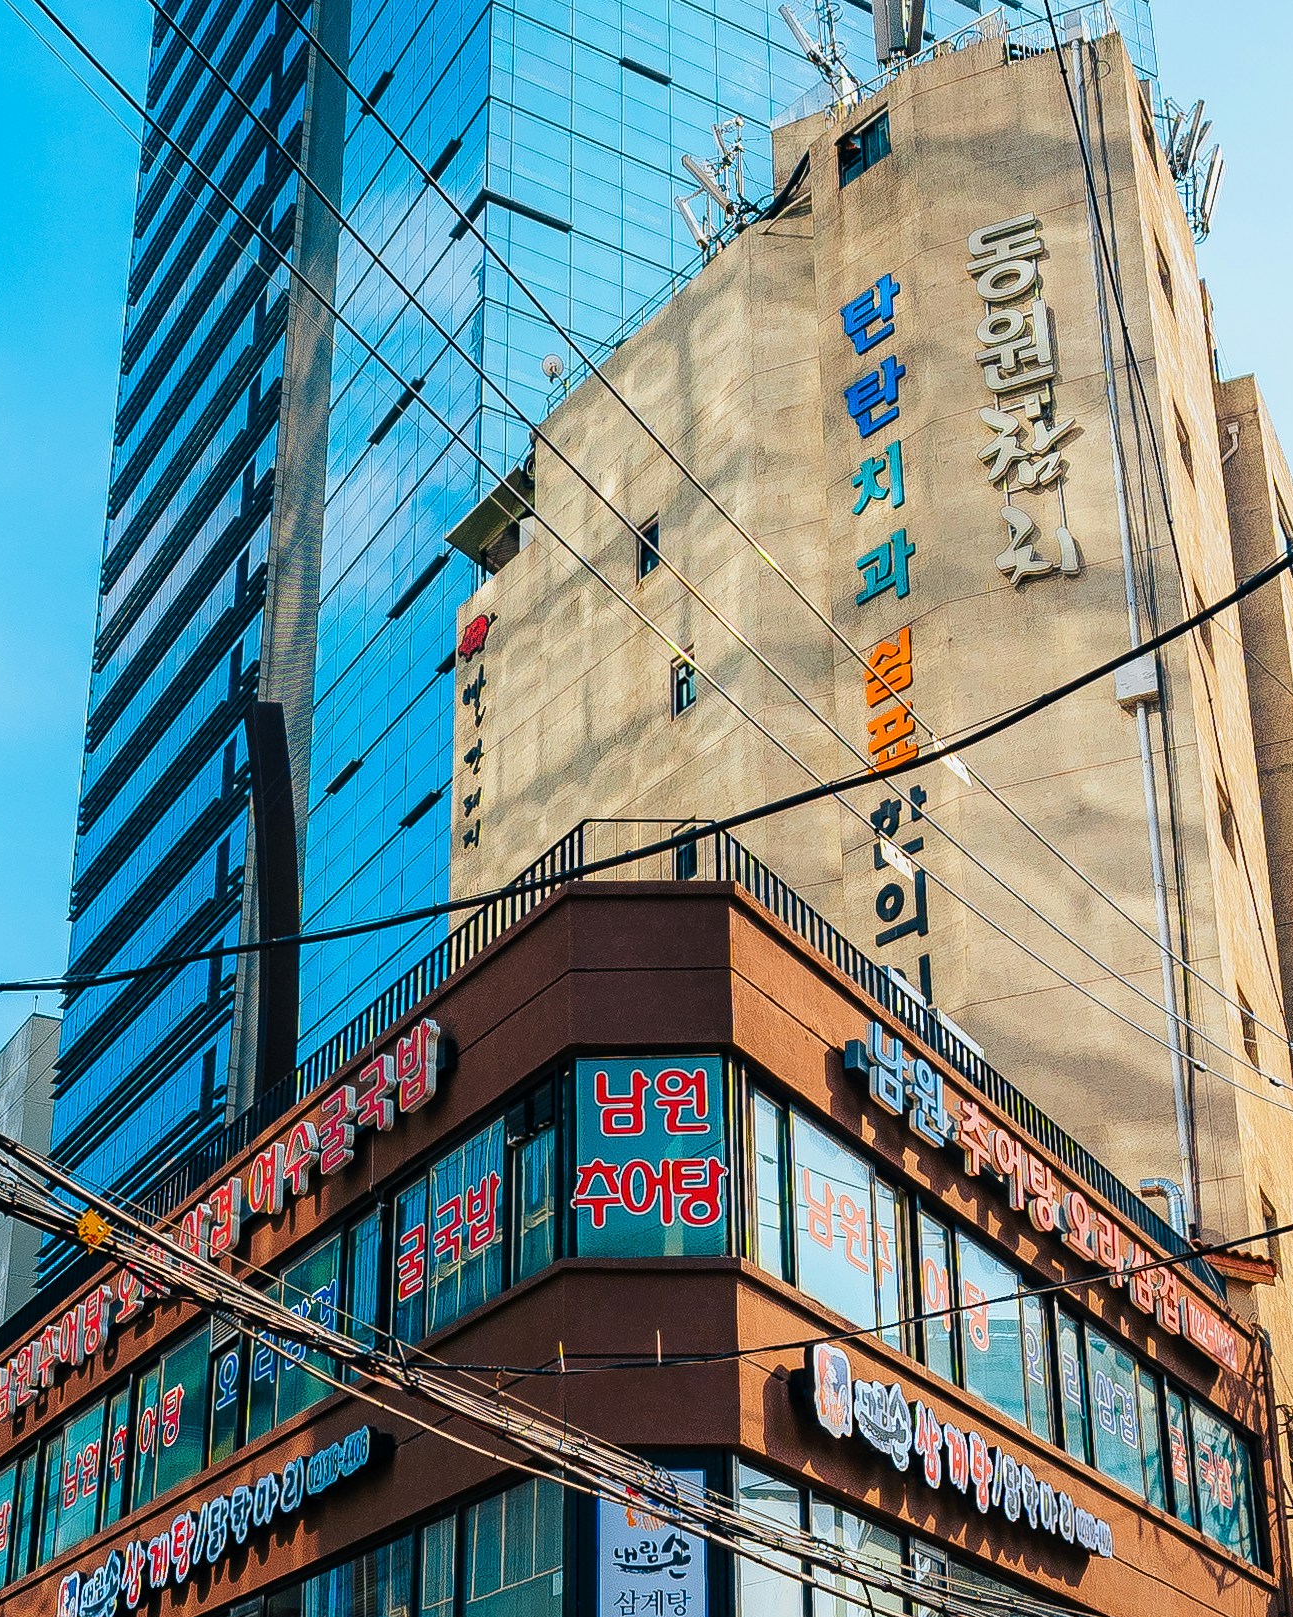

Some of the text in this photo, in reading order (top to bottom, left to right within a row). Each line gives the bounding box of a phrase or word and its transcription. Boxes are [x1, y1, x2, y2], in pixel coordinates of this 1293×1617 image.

[840, 273, 916, 606] 탄탄치과
[966, 211, 1076, 587] 동원참치
[249, 1018, 440, 1214] 여수굴국밥
[594, 1068, 710, 1137] 남원
[571, 1156, 729, 1229] 추어탕
[397, 1171, 501, 1302] 굴국밥
[1170, 1426, 1233, 1510] 굴국밥
[612, 1533, 692, 1580] 내림손
[614, 1589, 691, 1617] 삼계탕
